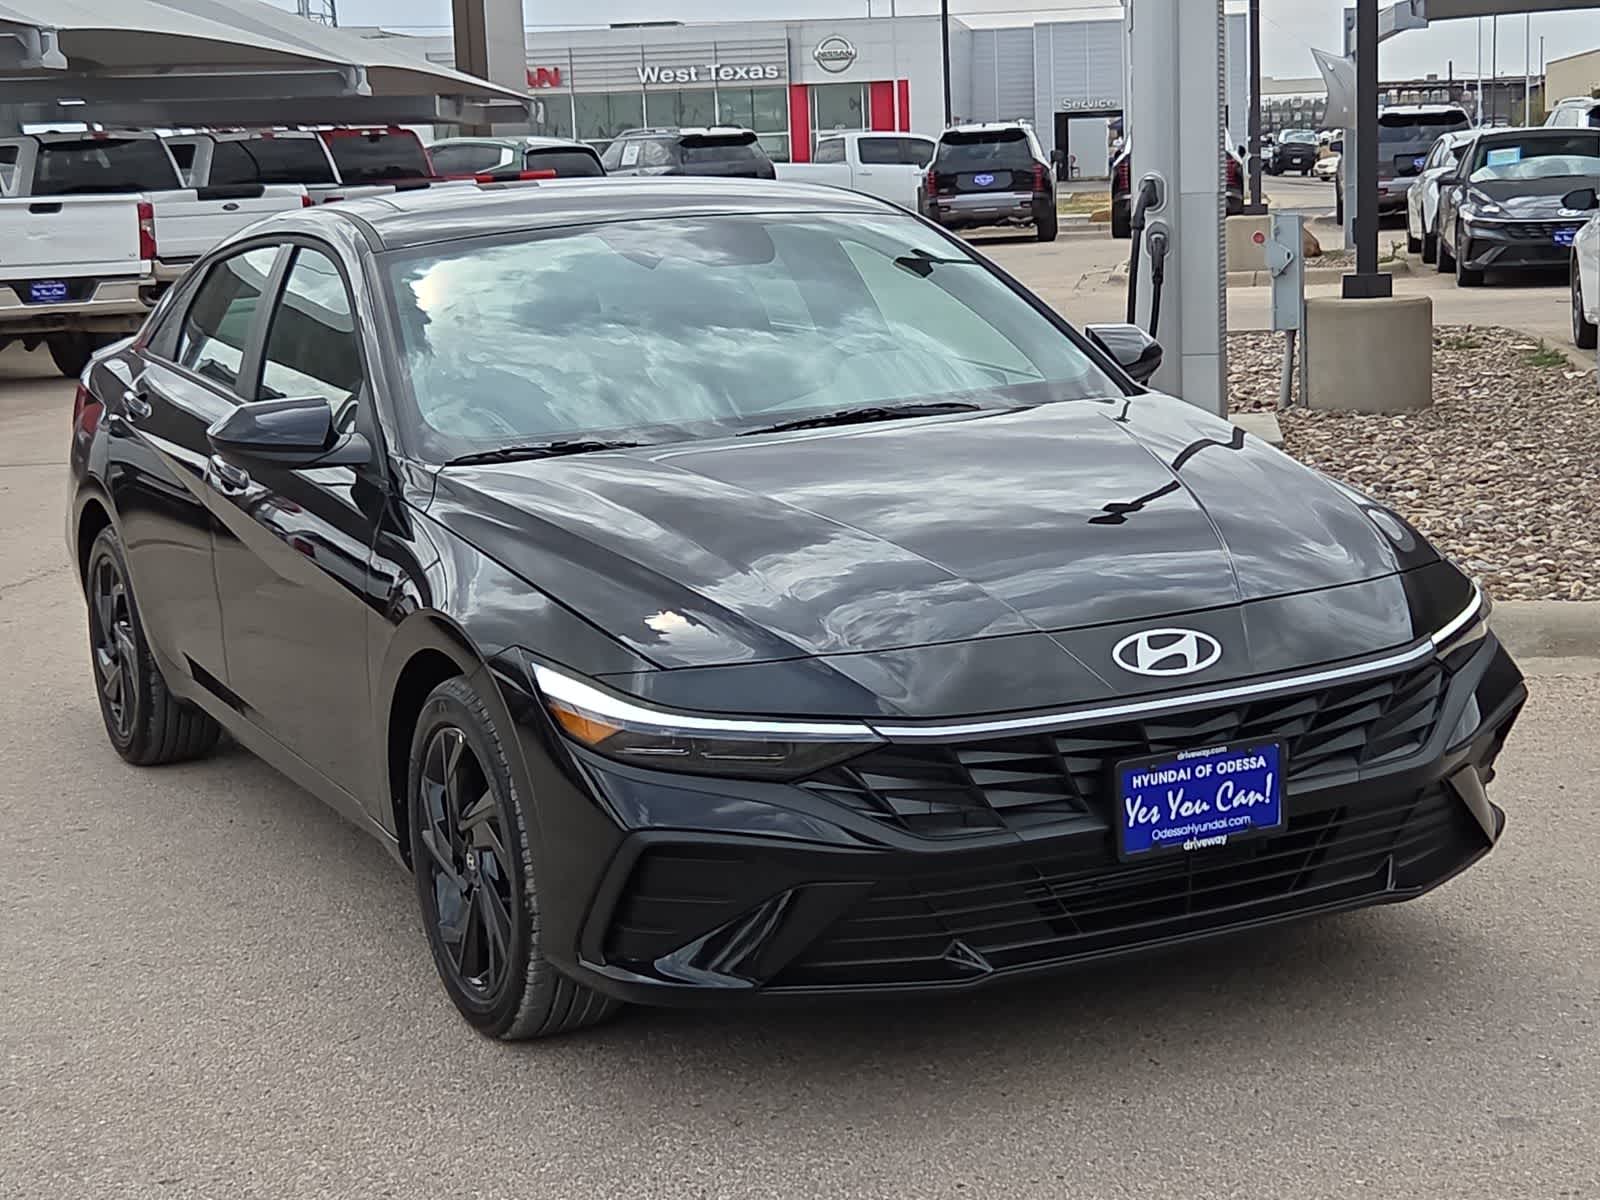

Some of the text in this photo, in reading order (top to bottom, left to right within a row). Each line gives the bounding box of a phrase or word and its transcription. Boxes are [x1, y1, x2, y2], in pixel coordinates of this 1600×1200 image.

[637, 63, 778, 84] West Texas
[1063, 98, 1115, 110] Service
[1177, 746, 1227, 761] driveway.com
[1132, 755, 1267, 789] HYUNDAI OF ODESSA
[1125, 772, 1273, 827] Yes You Can!
[1152, 815, 1251, 841] OdessaHyundai.com
[1183, 834, 1228, 851] driveway
